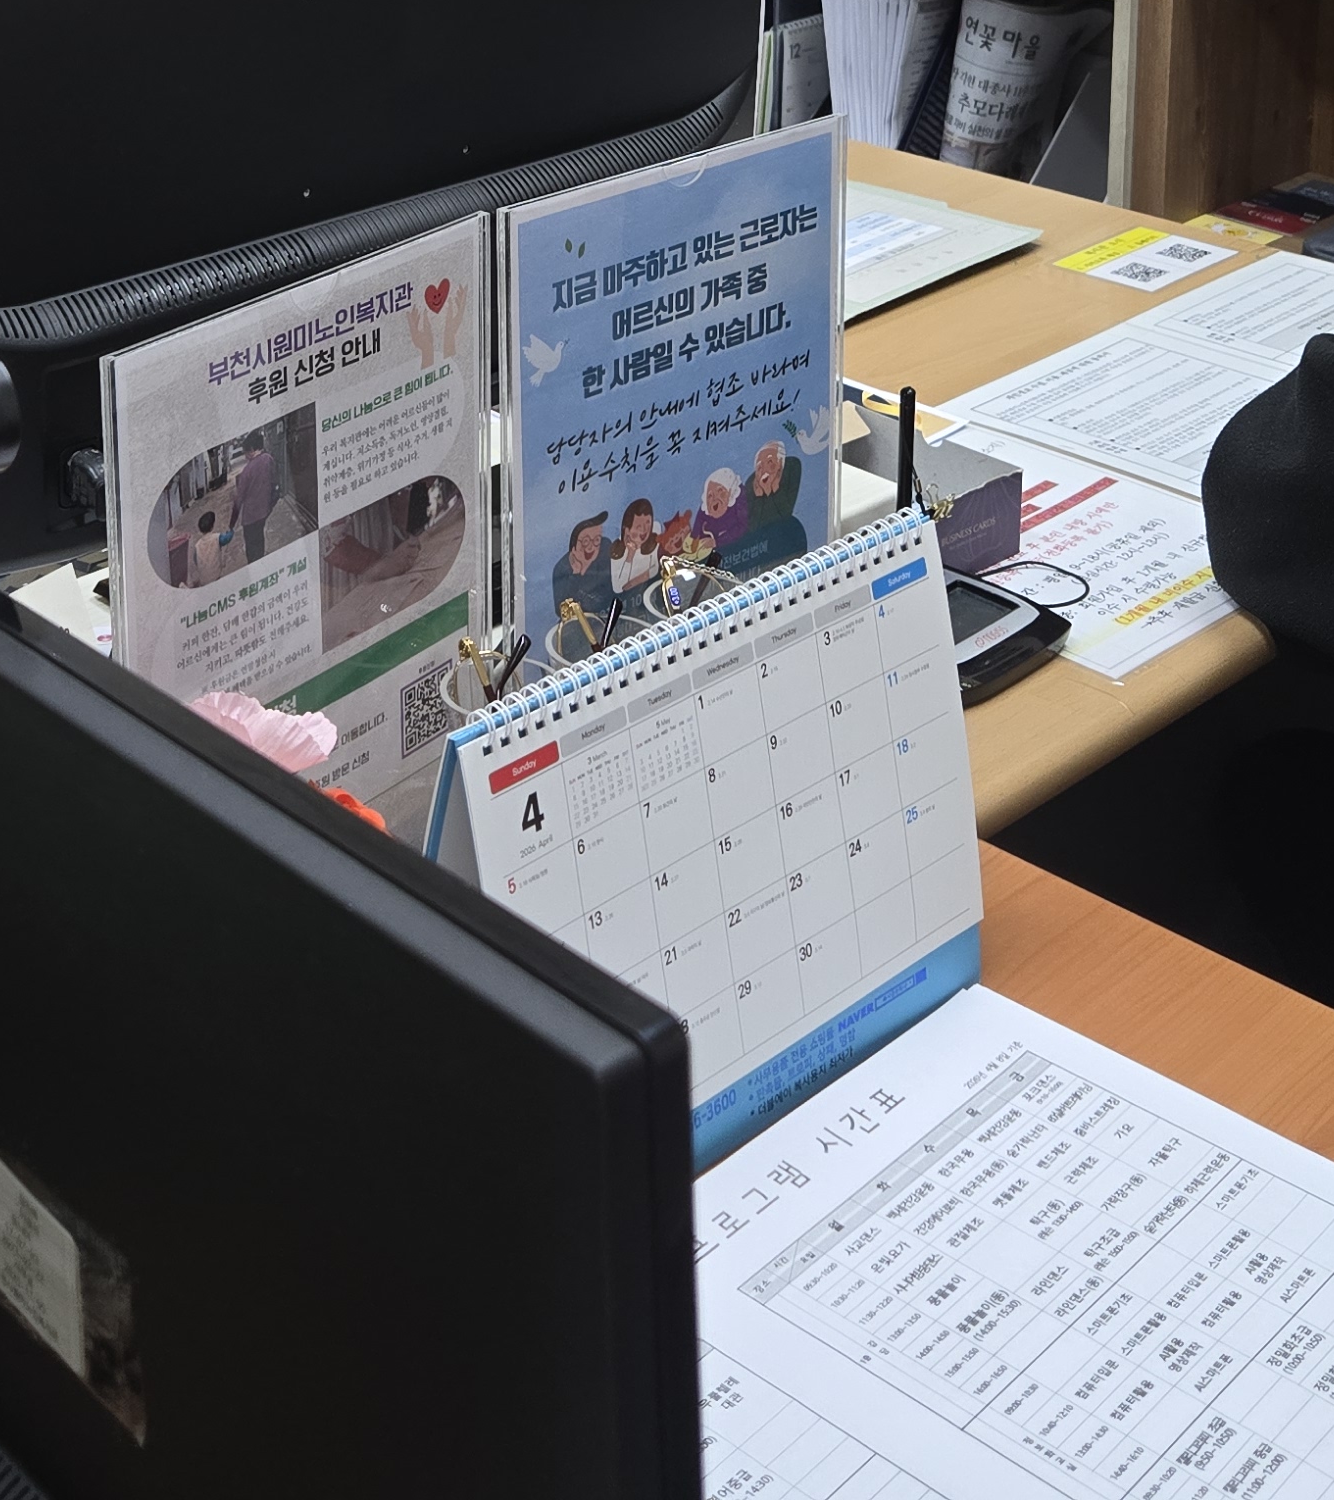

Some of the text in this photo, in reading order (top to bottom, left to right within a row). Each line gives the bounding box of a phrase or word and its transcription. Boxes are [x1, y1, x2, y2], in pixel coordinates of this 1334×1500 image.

[965, 15, 1042, 61] 연꽃마을
[552, 270, 597, 313] 지금
[602, 241, 688, 296] 마주하고
[693, 230, 736, 267] 있는
[740, 203, 819, 253] 근로자는
[612, 262, 768, 341] 어르신의 가족 중
[208, 281, 414, 386] 부천시원미노인복지관
[248, 327, 382, 405] 후원 신청 안내
[582, 302, 792, 399] 한 사람일 수 있습니다.
[321, 363, 454, 433] 당신의 나눔으로 큰 힘이 됩니다.
[546, 348, 811, 466] 담당자의 안내에 협조 바라며
[666, 428, 687, 456] 꼭
[691, 388, 802, 444] 지켜주세요!
[322, 441, 338, 456] 우리
[972, 517, 997, 535] CARDS
[180, 556, 307, 629] "나눔CMS 후원계좌" 개설
[292, 580, 308, 596] 우리
[887, 569, 912, 588] Saturday
[771, 627, 798, 645] Thursday
[176, 639, 228, 671] 어르신에게는
[706, 656, 740, 677] Wednesday
[829, 700, 843, 718] 10
[341, 711, 388, 746] 이동합니다.
[581, 722, 606, 740] Monday
[896, 738, 910, 756] 18
[332, 750, 371, 781] 방문 신청
[512, 759, 537, 777] Sunday
[521, 791, 545, 832] 4
[519, 834, 554, 859] 2026 April
[718, 836, 732, 855] 15
[848, 839, 862, 858] 24
[798, 943, 813, 962] 30
[838, 1003, 875, 1033] NAVER
[1022, 1073, 1057, 1103] 포크댄스
[816, 1088, 906, 1154] 시간표
[1114, 1123, 1135, 1140] 가요
[937, 1148, 975, 1178] 한국무용
[1147, 1137, 1183, 1169] 자율탁구
[959, 1158, 1009, 1199] 한국무용(동)
[1064, 1155, 1100, 1186] 근력체조
[1100, 1172, 1148, 1212] 가락장구(동)
[1214, 1168, 1260, 1212] 스마트폰기초
[1029, 1199, 1065, 1227] 탁구(동)
[845, 1225, 882, 1257] 사교댄스
[870, 1240, 912, 1275] 은빛요가
[926, 1273, 967, 1308] 풍물놀이
[1031, 1264, 1070, 1297] 라인댄스
[1166, 1271, 1209, 1310] 컴퓨터입문
[1201, 1290, 1243, 1330] 컴퓨터활용
[1265, 1323, 1313, 1368] 정밀화초급
